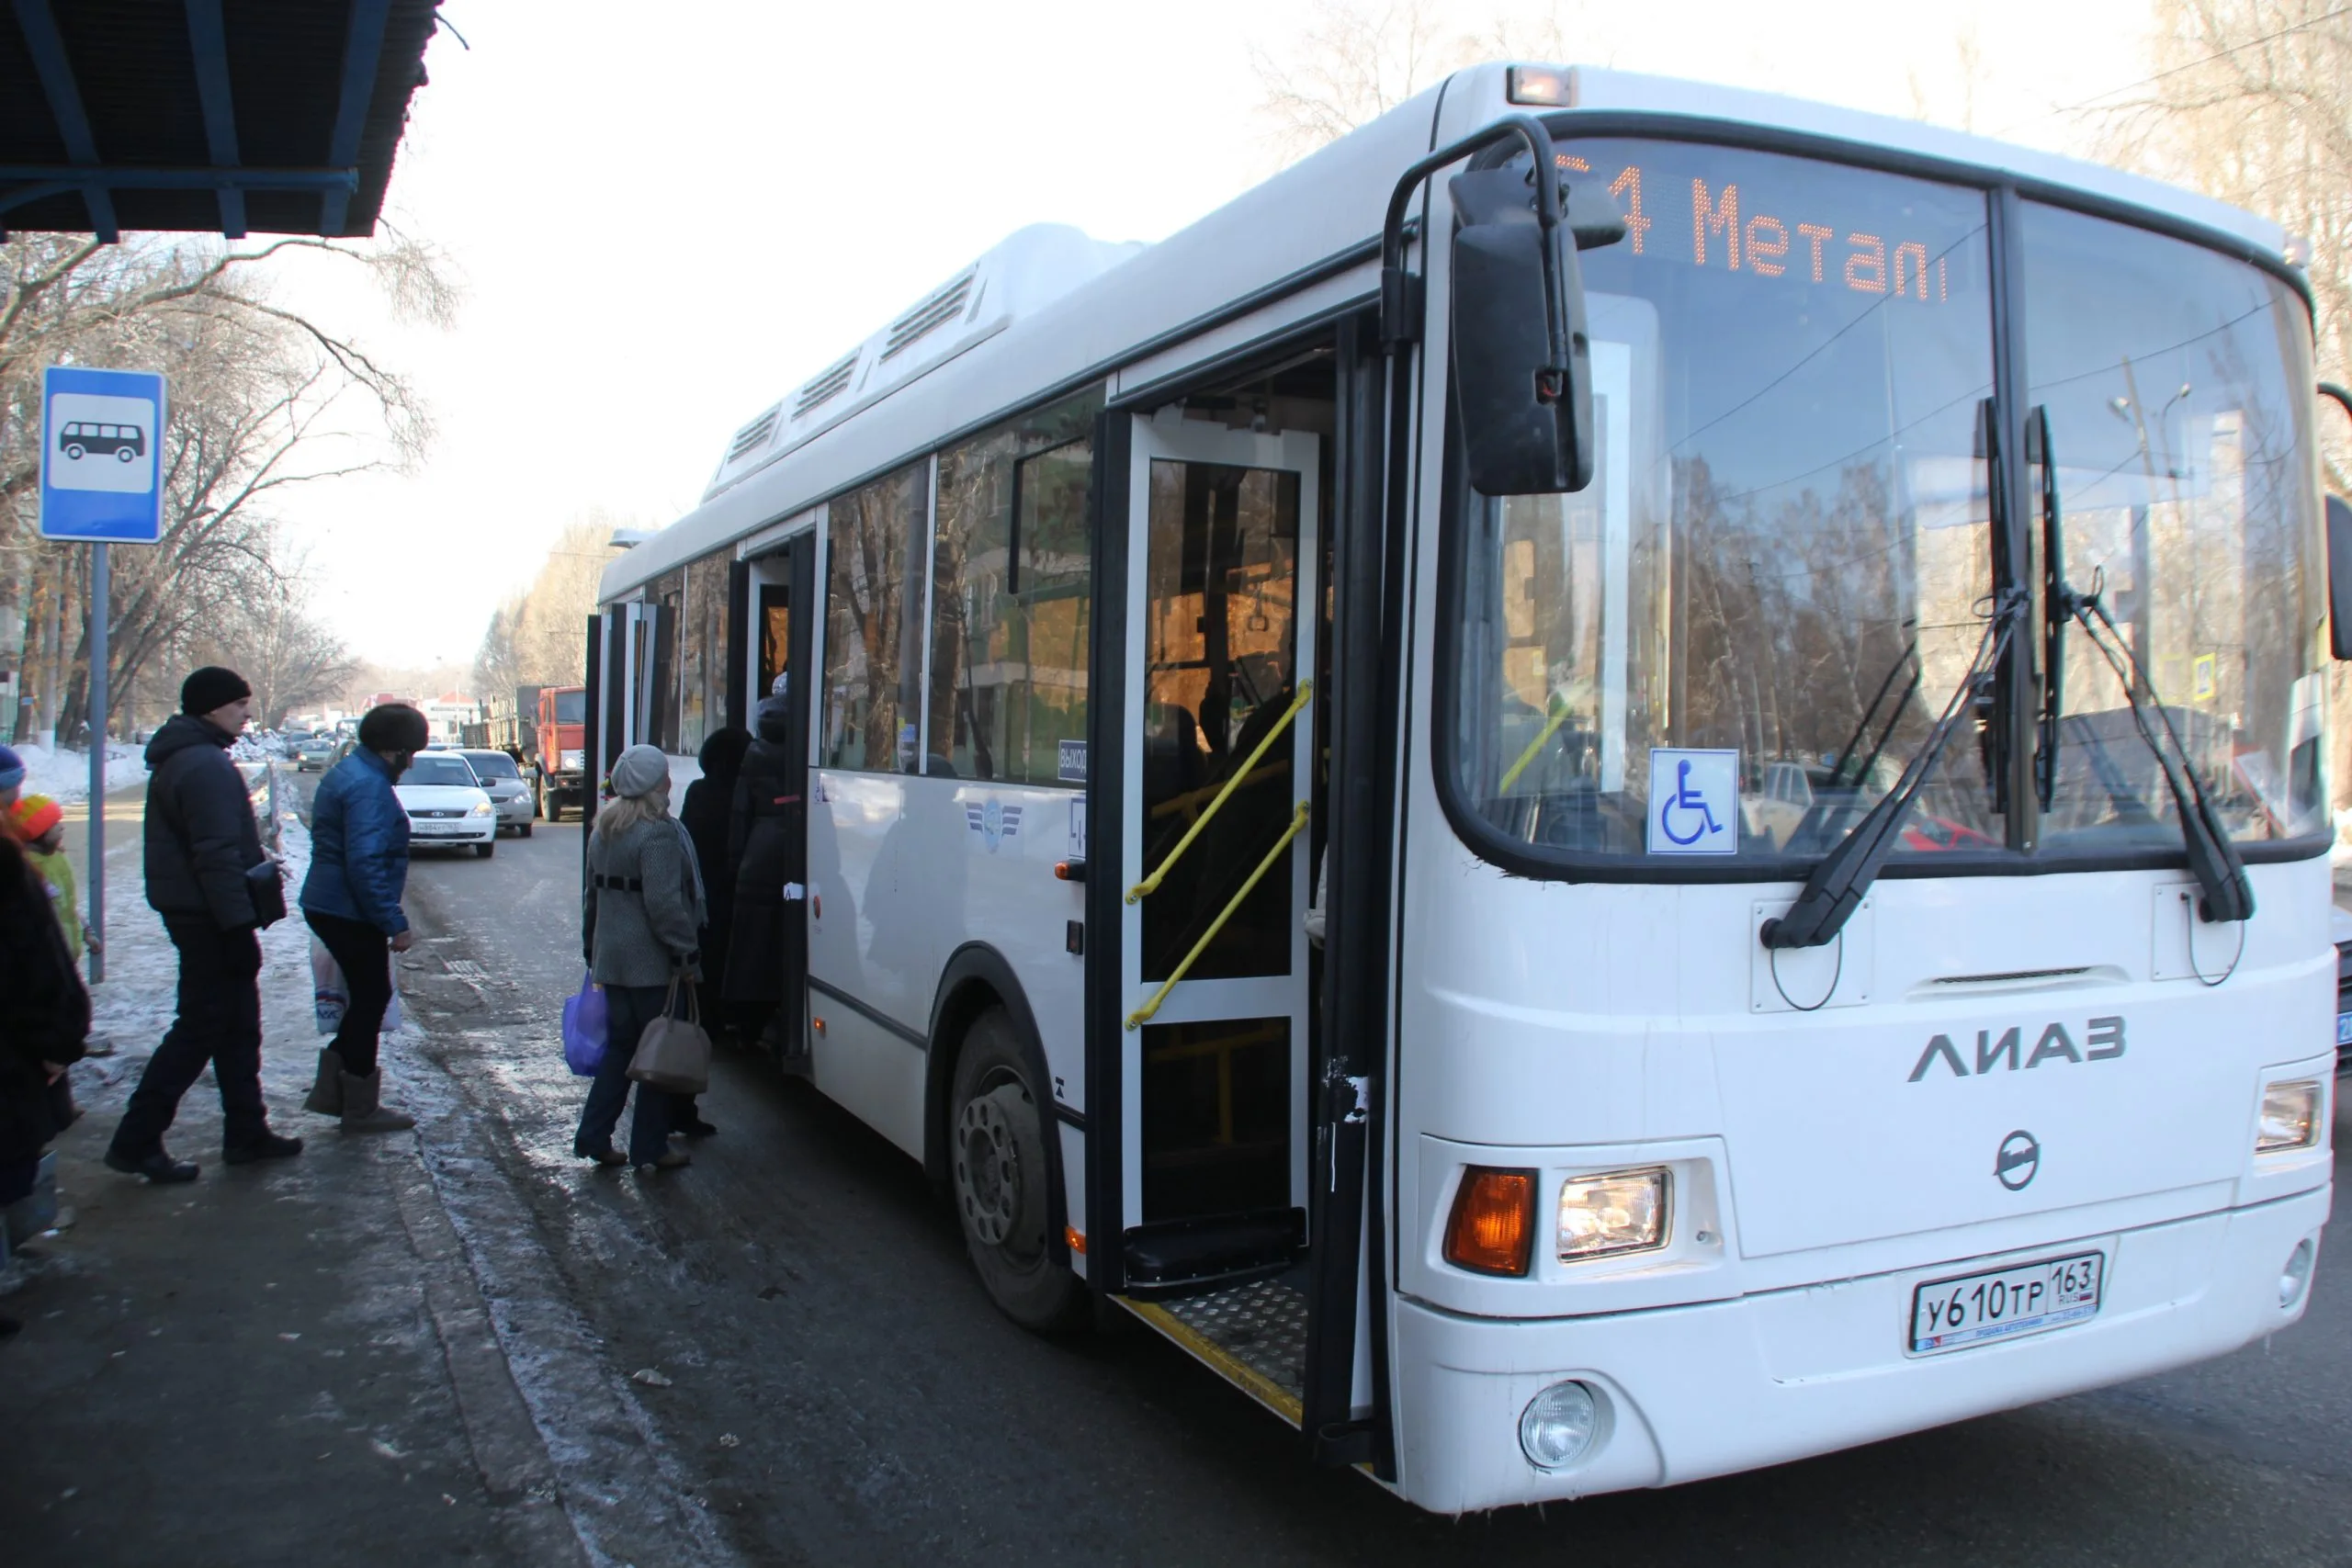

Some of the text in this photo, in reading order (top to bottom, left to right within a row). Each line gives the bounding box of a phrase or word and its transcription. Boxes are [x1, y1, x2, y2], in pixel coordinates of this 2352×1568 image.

[1060, 748, 1087, 774] ВЫХОД
[1905, 1015, 2127, 1083] ЛИАЗ
[2051, 1259, 2093, 1295] 163
